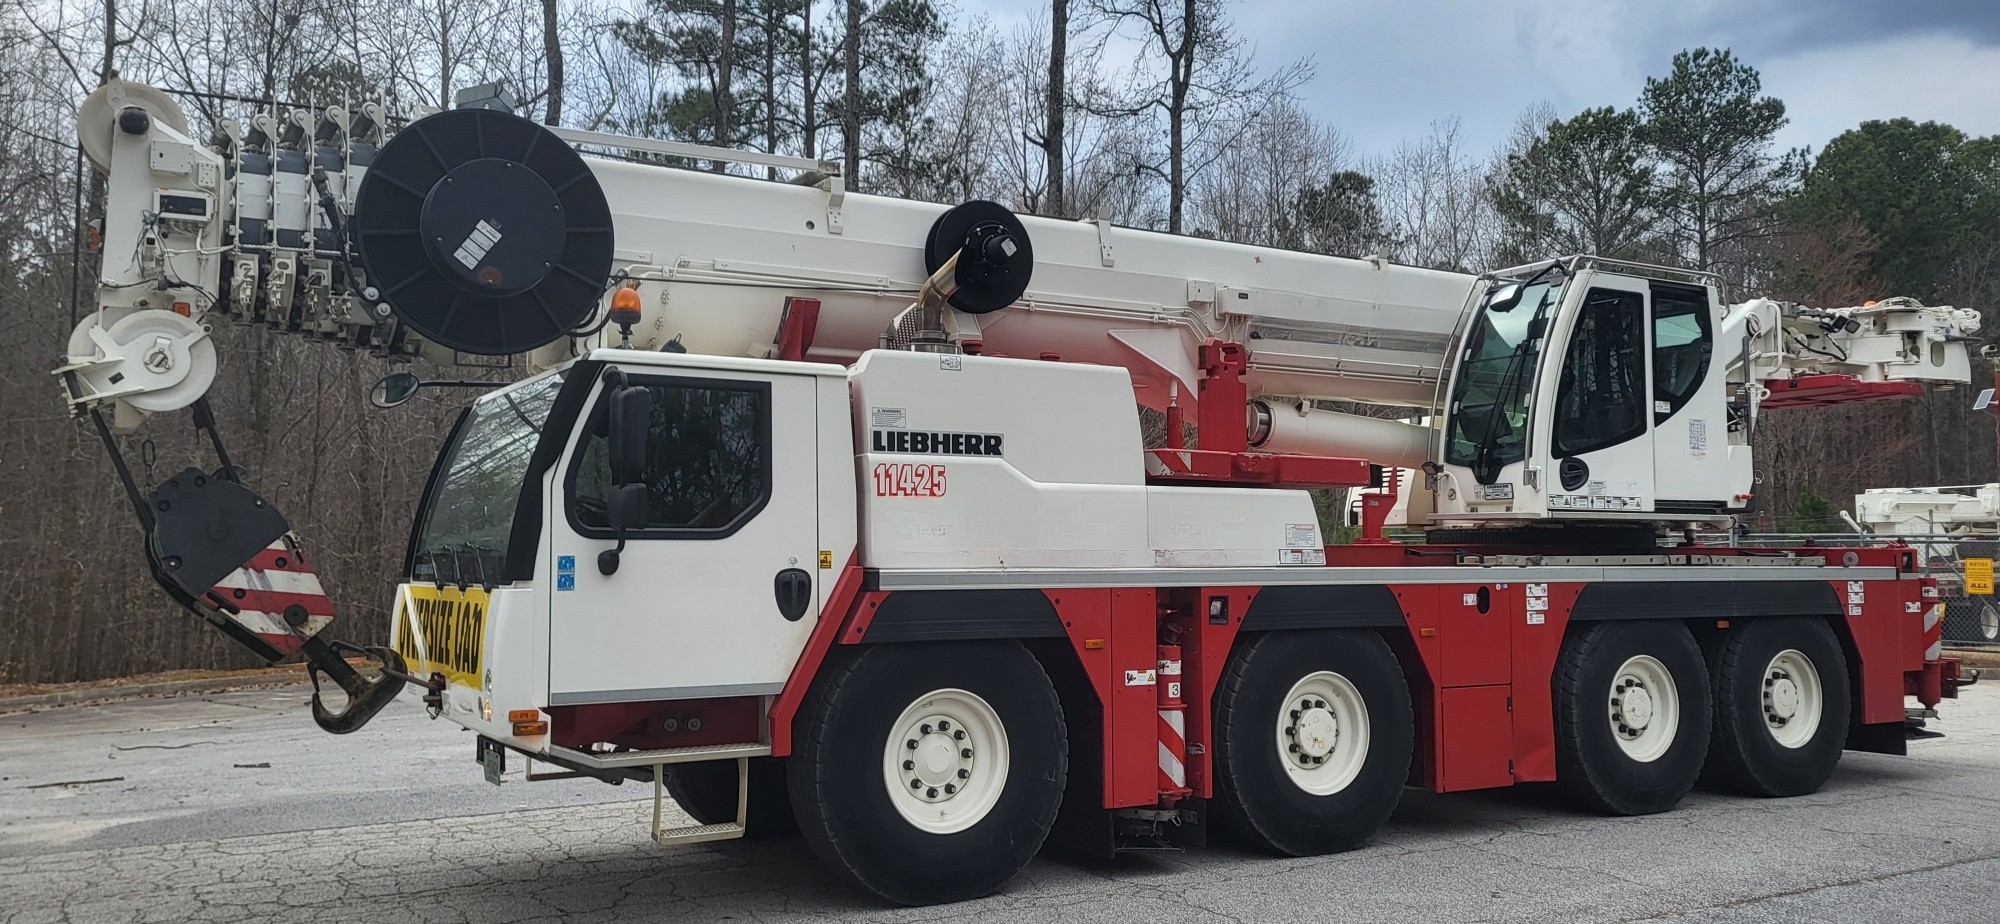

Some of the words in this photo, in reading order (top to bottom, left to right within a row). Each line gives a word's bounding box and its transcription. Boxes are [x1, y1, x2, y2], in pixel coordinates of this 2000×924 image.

[872, 430, 1003, 456] LIEBHERR
[874, 463, 947, 497] 11425
[1172, 683, 1179, 696] 3
